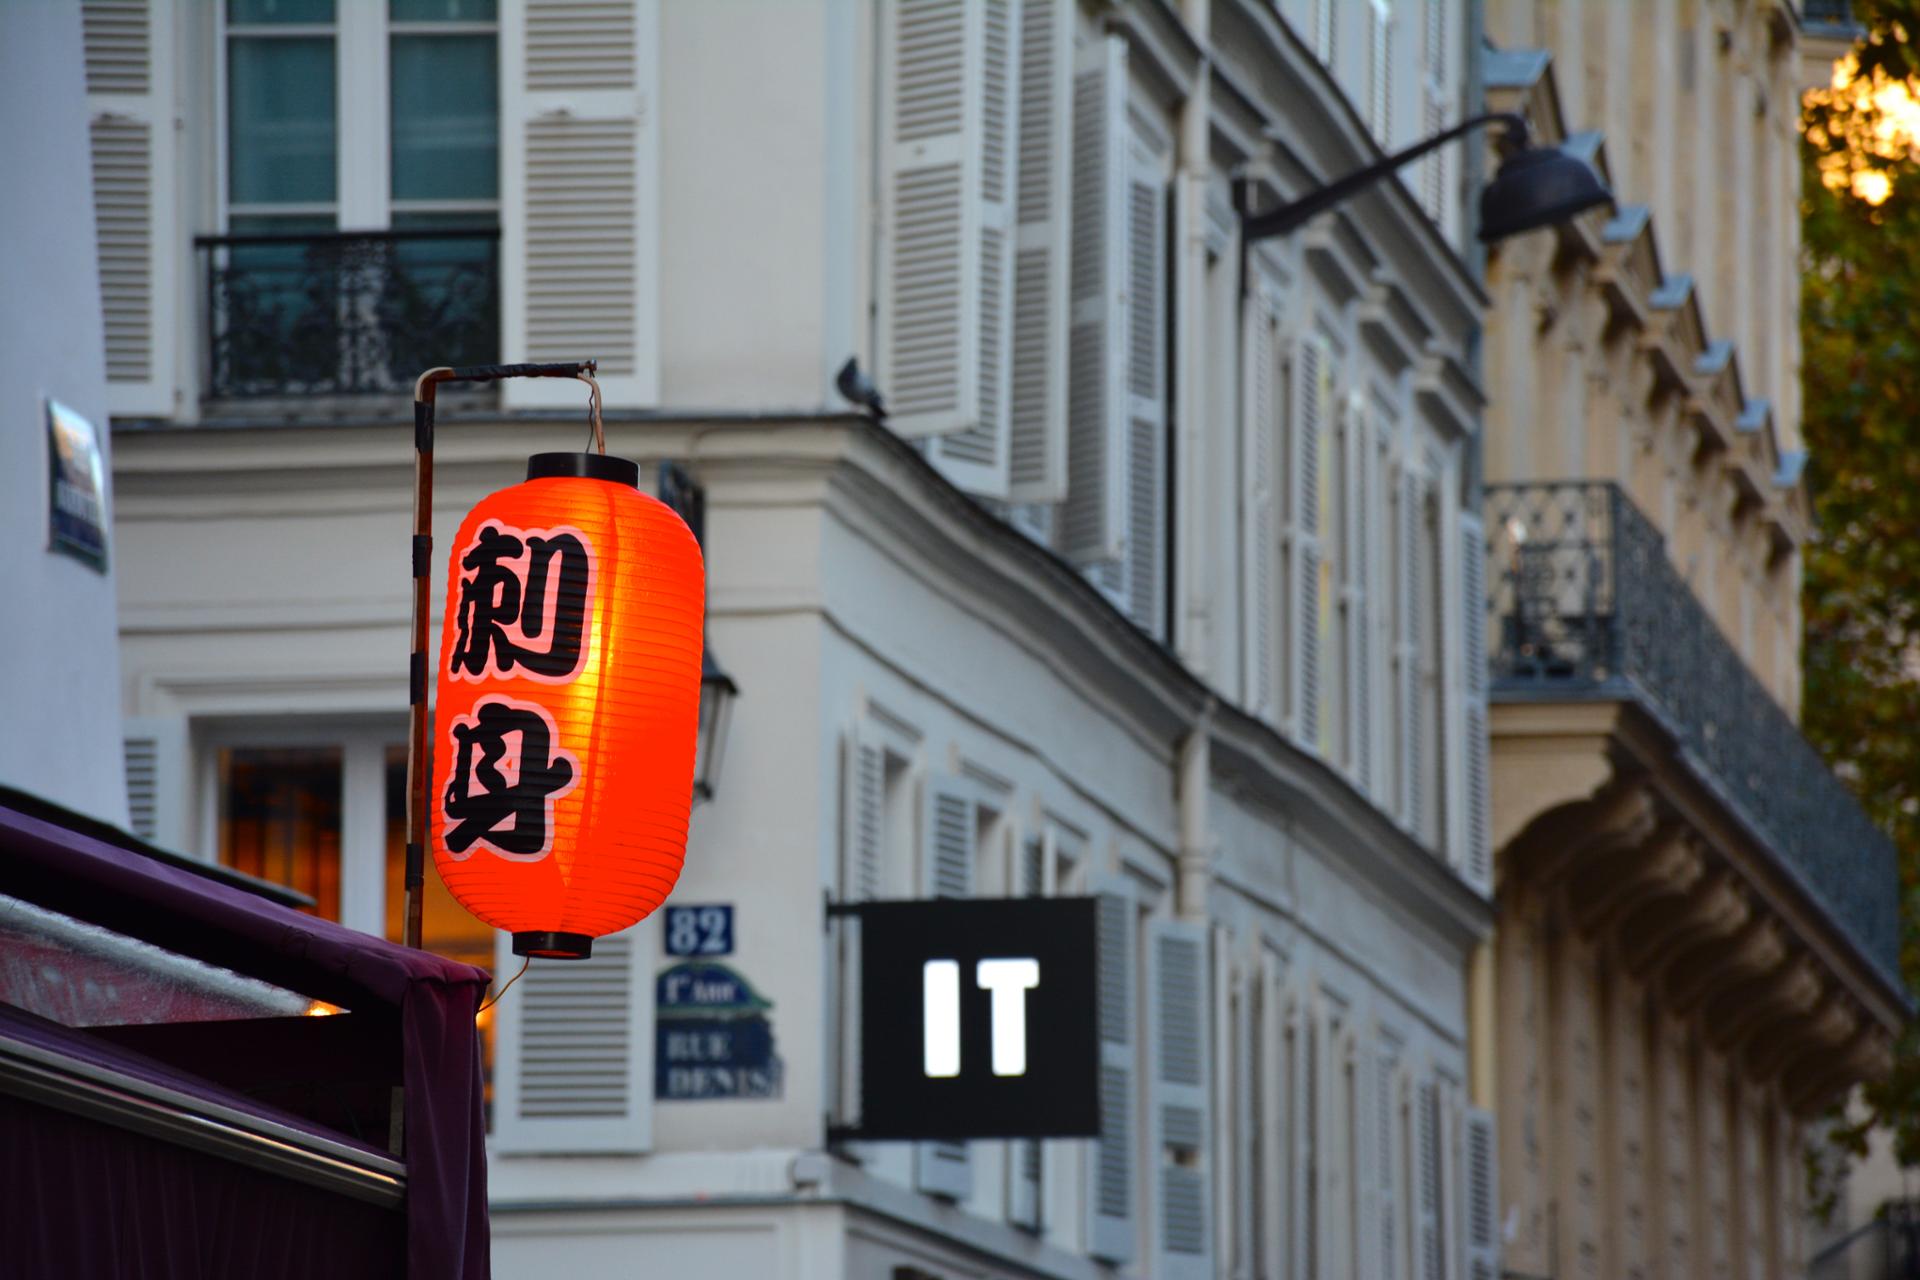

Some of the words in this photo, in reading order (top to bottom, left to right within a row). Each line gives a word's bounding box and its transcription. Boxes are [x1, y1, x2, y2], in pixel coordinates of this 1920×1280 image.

[444, 523, 591, 857] 刺身
[670, 907, 728, 954] 82
[923, 957, 1041, 1078] IT
